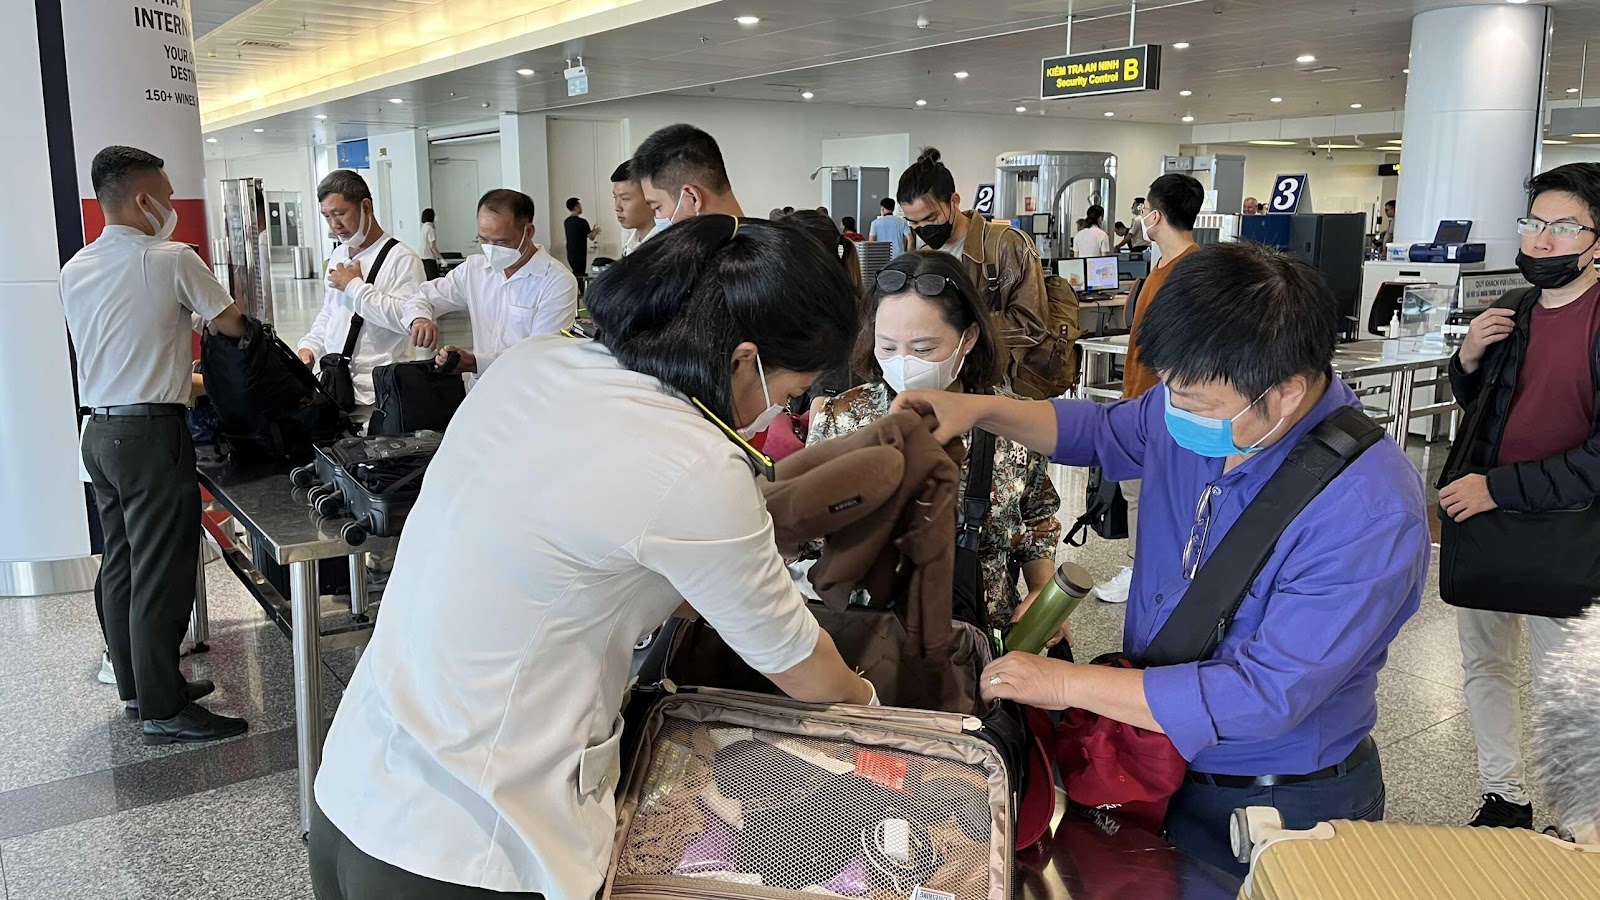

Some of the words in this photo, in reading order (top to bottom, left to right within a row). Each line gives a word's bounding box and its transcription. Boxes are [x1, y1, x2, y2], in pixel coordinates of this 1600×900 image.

[135, 6, 190, 37] INTERN
[163, 44, 189, 64] YOUR
[1067, 64, 1084, 75] TRA
[1084, 62, 1098, 73] AN
[1098, 59, 1120, 71] NINH
[1124, 58, 1139, 80] B
[1056, 76, 1088, 88] Security
[1088, 72, 1119, 85] Control
[145, 89, 173, 102] 150+
[976, 187, 993, 212] 2
[1273, 178, 1298, 210] 3
